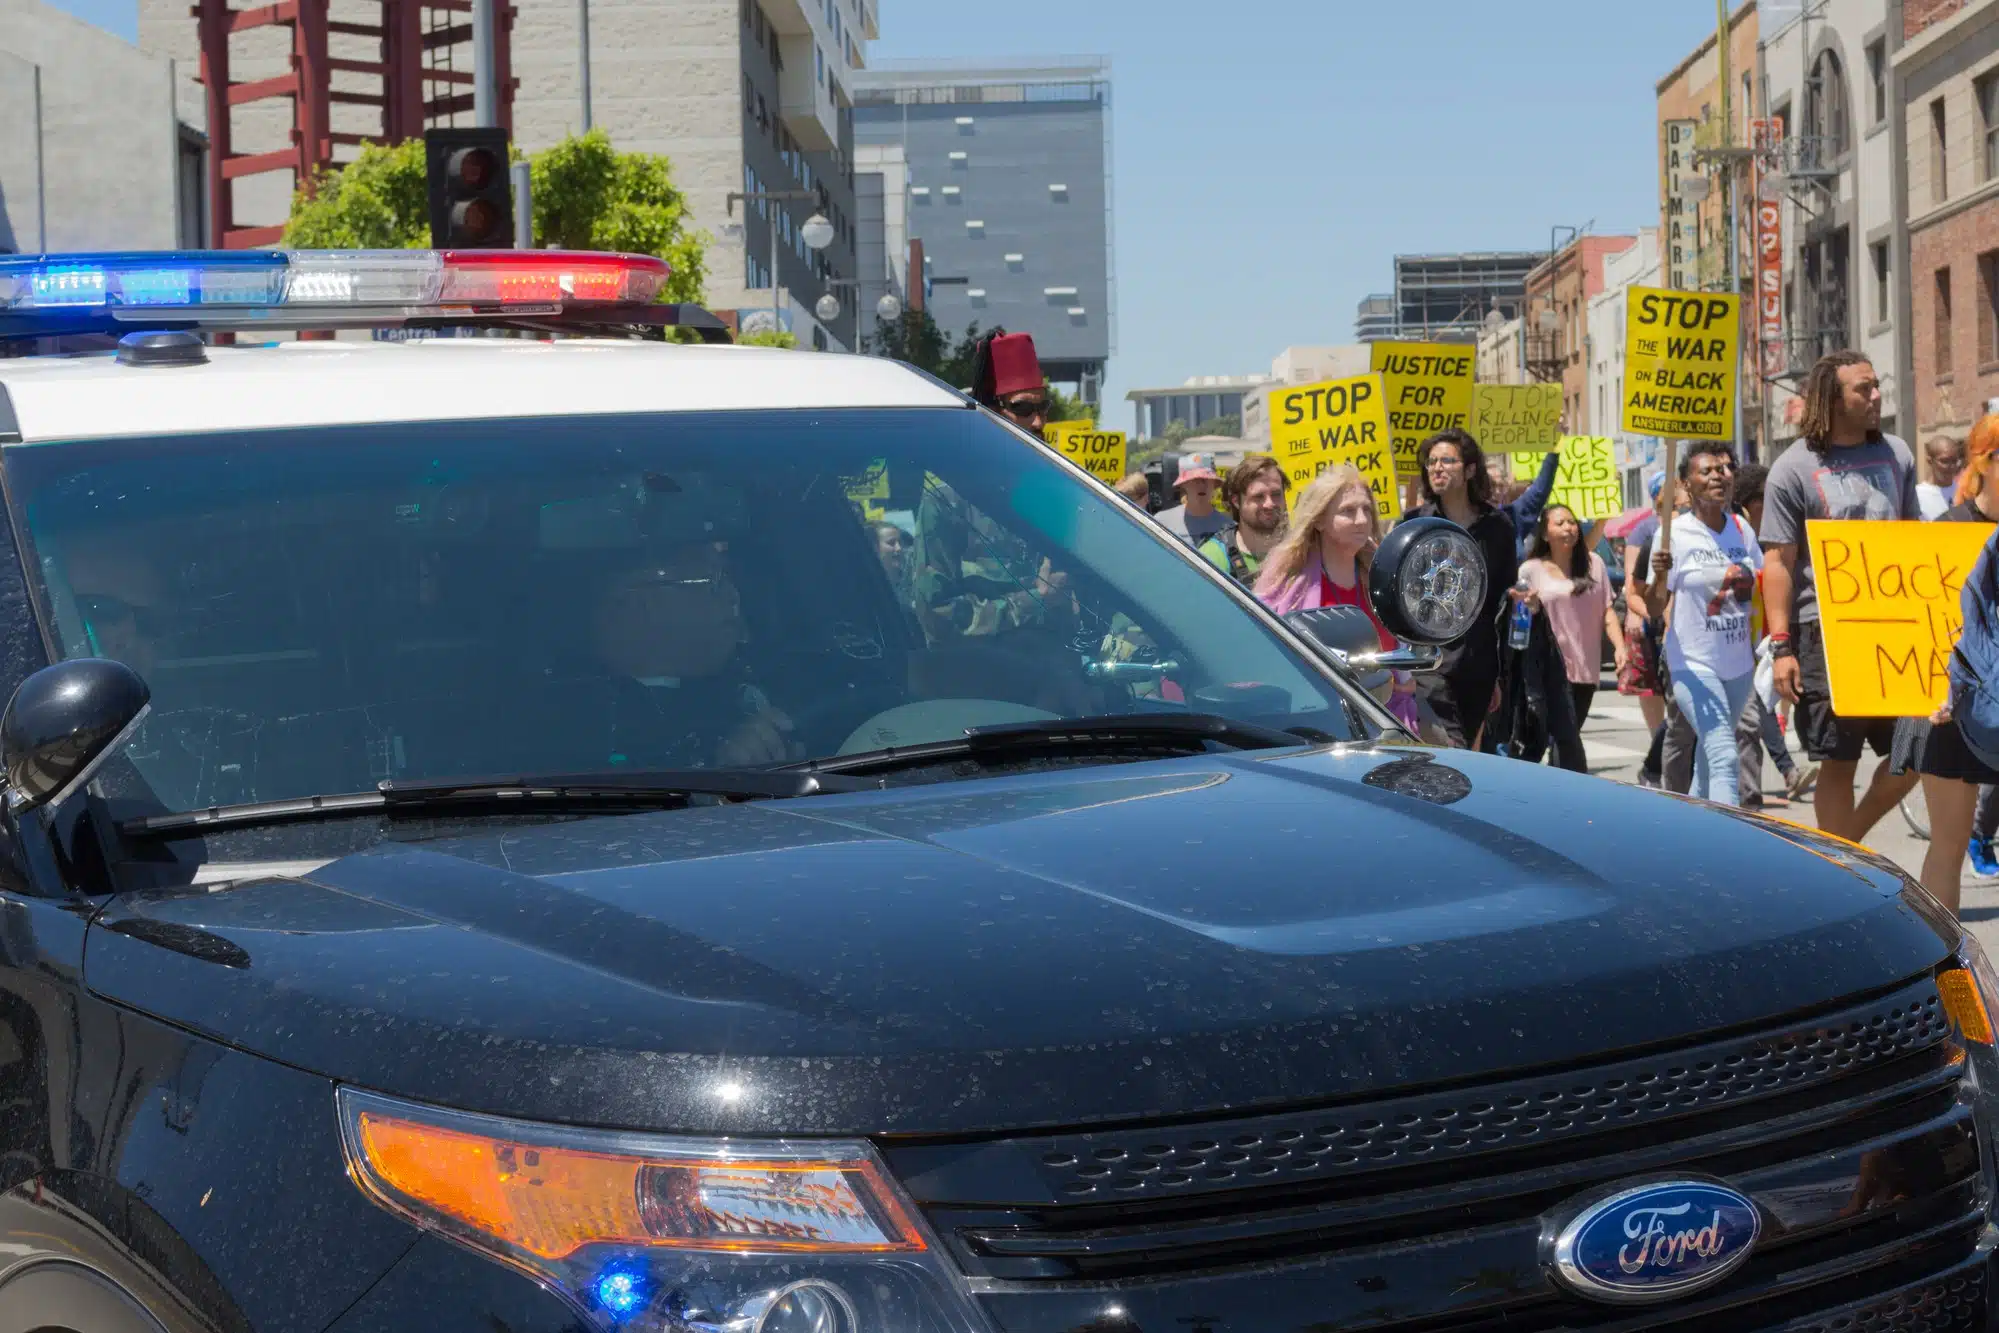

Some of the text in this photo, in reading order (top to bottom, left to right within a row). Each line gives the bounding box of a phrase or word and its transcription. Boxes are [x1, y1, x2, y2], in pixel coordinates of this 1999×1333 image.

[1670, 125, 1683, 288] DAIMARU
[1638, 294, 1730, 330] STOP
[1636, 337, 1727, 362] THE WAR
[1377, 354, 1471, 377] JUSTICE
[1636, 369, 1727, 391] ON BLACK
[1284, 382, 1373, 426] STOP
[1400, 385, 1446, 407] FOR
[1478, 385, 1558, 412] STOP
[1628, 391, 1728, 417] AMERICA!
[1388, 411, 1467, 432] REDDIE
[1478, 410, 1558, 427] KILLING
[1632, 416, 1721, 434] ANSWERLA.ORG
[1066, 434, 1120, 454] STOP
[1288, 420, 1377, 453] THE WAR
[1480, 427, 1557, 446] PEOPLE!
[1085, 458, 1119, 473] WAR
[1294, 467, 1311, 481] ON
[1821, 539, 1962, 604] Black
[1619, 1201, 1724, 1273] Ford
